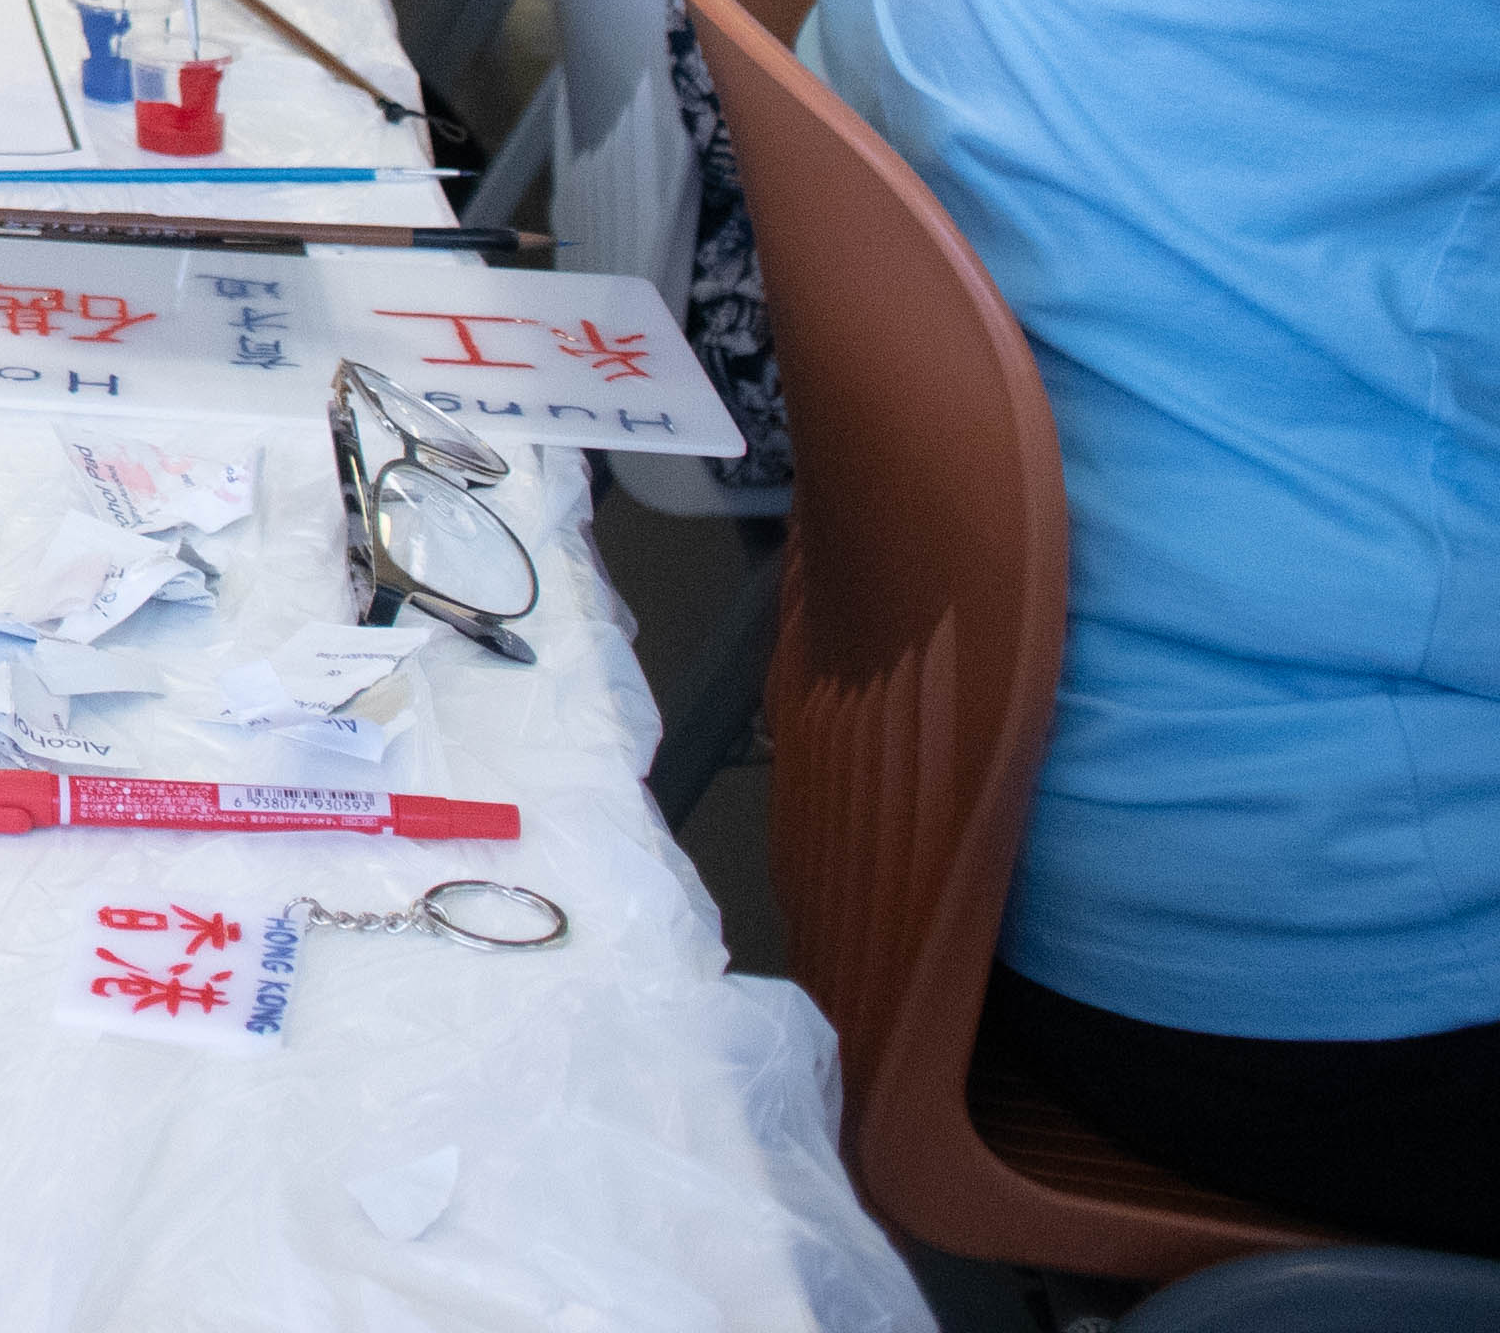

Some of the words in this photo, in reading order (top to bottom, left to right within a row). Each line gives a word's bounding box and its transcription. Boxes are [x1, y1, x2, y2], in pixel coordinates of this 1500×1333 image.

[420, 389, 676, 435] Hung
[73, 443, 107, 483] Pad
[13, 712, 111, 757] Alcohol
[233, 797, 243, 809] 6
[252, 797, 307, 810] 938074
[315, 798, 371, 812] 930593
[90, 904, 242, 1017] 香港
[261, 917, 300, 974] HONG
[245, 979, 292, 1036] KONG
